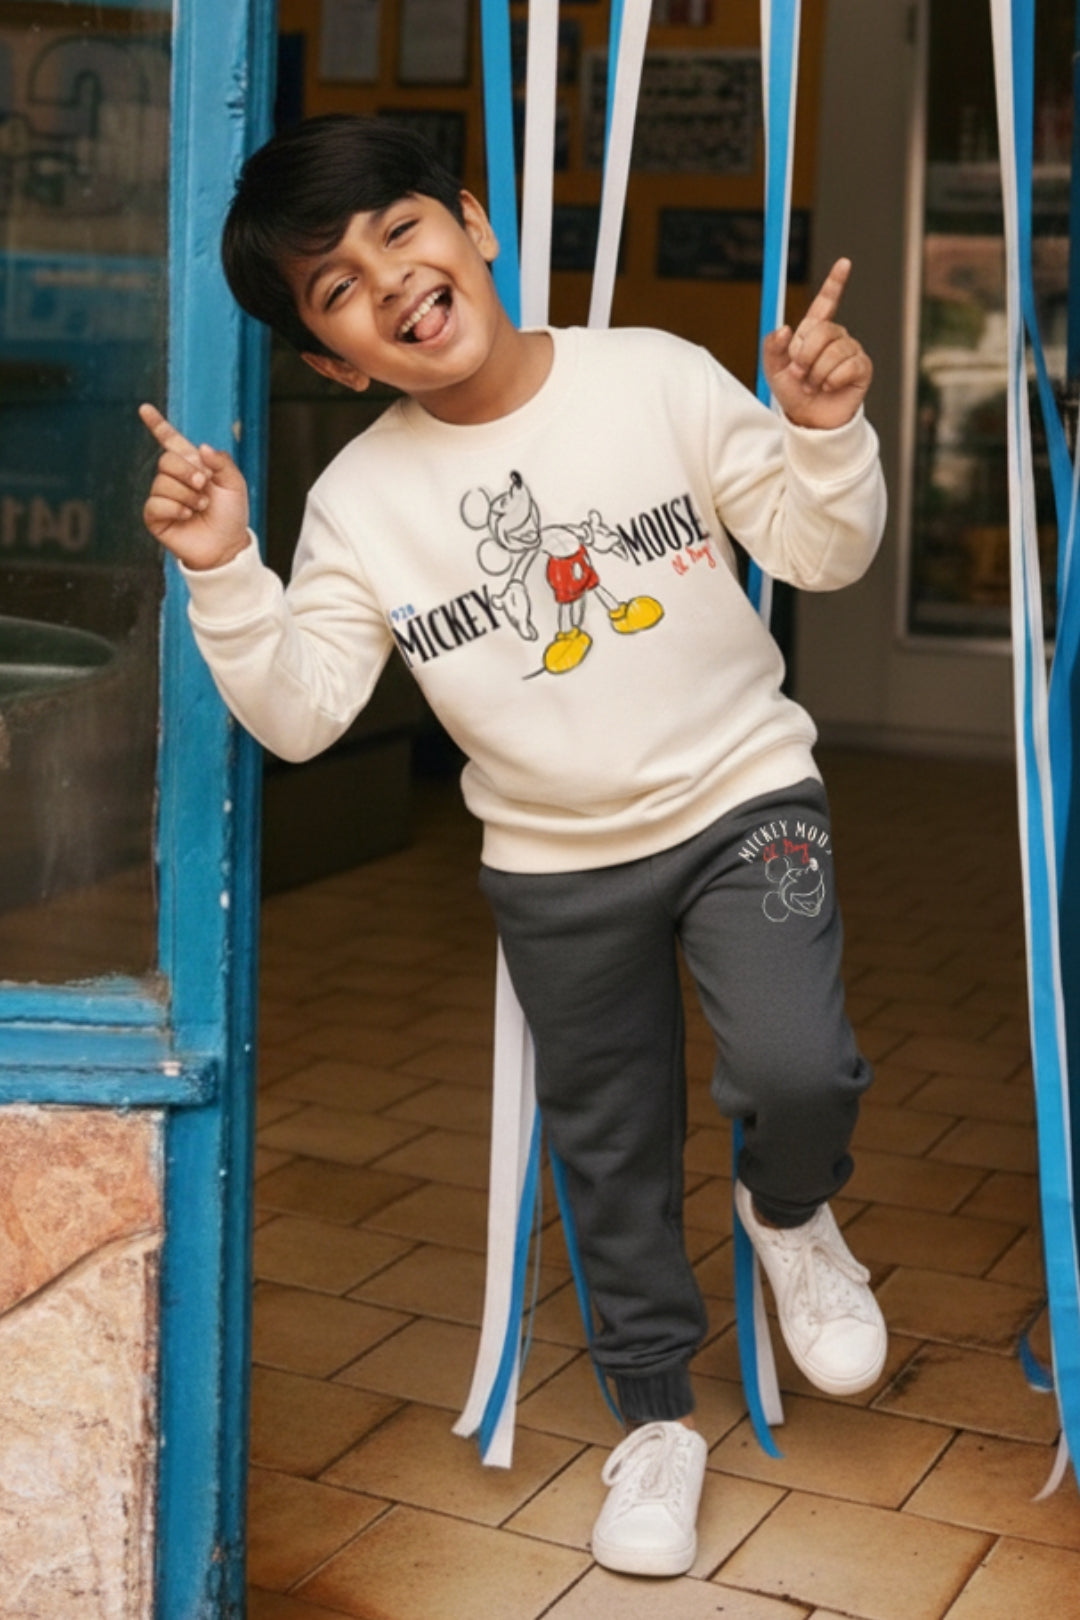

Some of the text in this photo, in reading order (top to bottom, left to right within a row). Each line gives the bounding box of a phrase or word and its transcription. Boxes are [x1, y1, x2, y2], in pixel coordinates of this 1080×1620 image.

[617, 494, 710, 566] MOUSE
[392, 584, 500, 668] MICKEY
[738, 820, 787, 863] MICKEY
